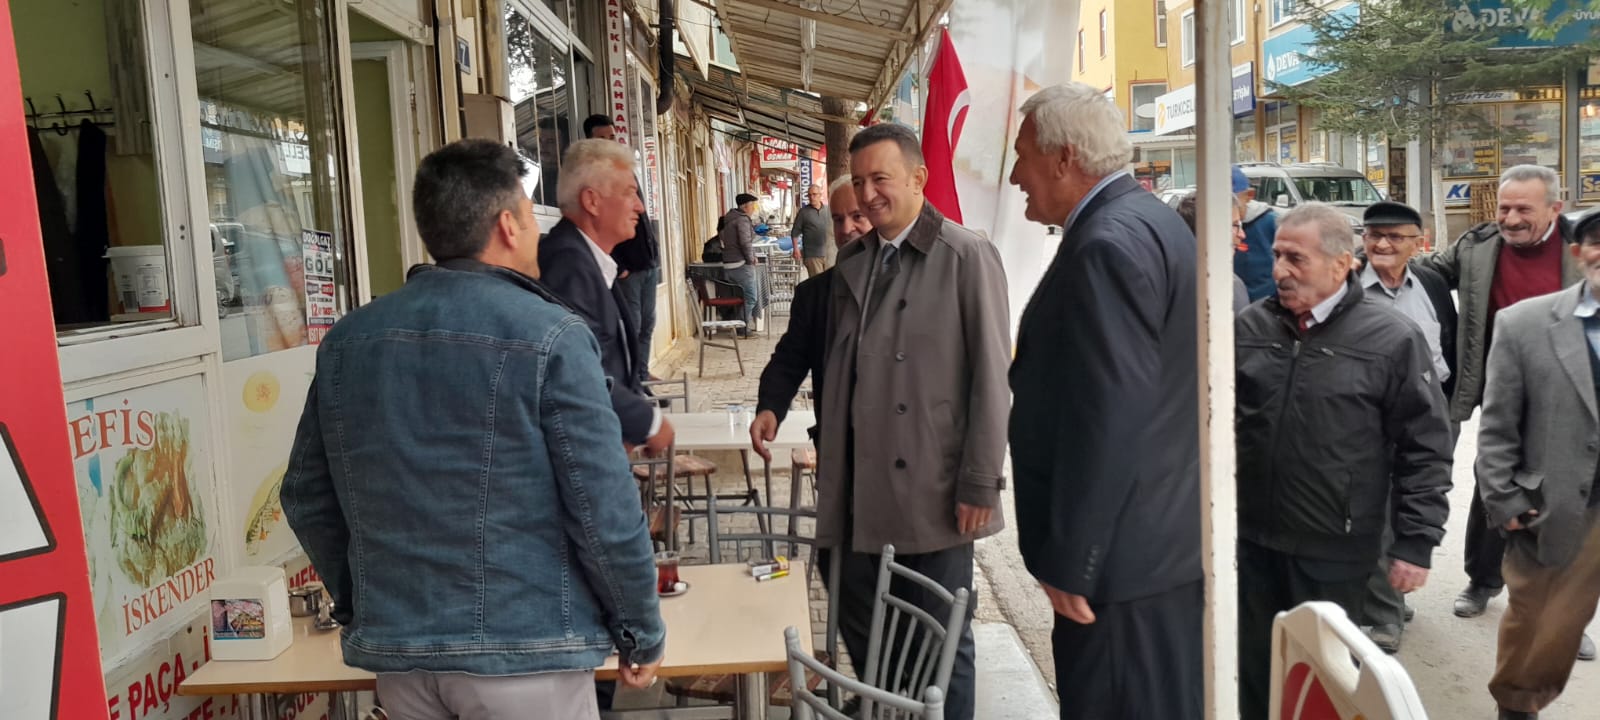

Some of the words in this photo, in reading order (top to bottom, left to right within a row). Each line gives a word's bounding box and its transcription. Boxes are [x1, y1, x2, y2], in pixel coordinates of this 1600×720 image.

[460, 43, 468, 65] 7
[1276, 50, 1300, 73] DEVA
[69, 399, 154, 460] EFİS
[122, 557, 215, 637] İSKENDER
[128, 653, 186, 720] PAÇA
